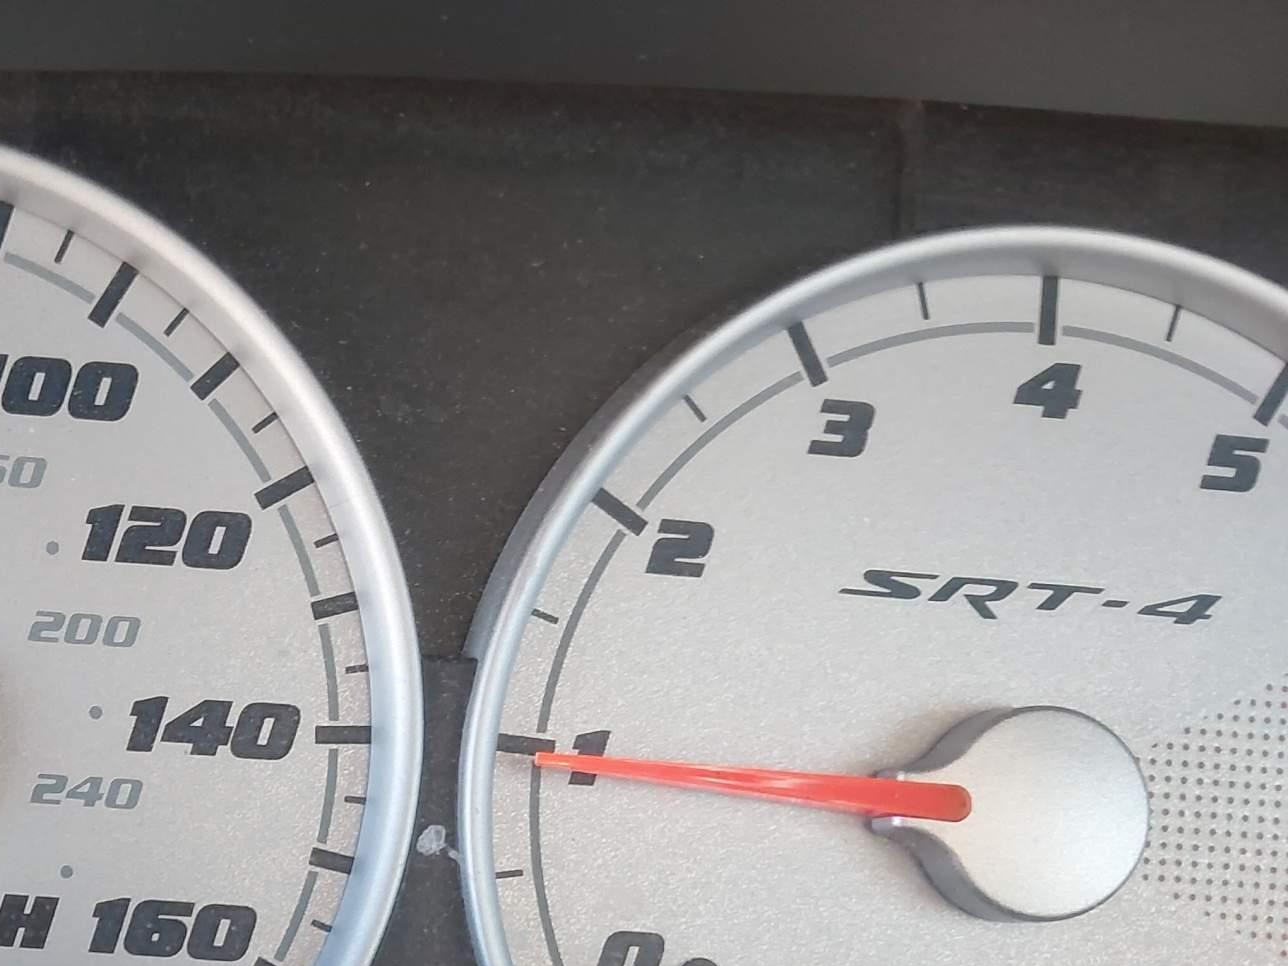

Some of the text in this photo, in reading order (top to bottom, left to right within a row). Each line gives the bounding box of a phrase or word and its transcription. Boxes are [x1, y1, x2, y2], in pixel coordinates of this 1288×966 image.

[1013, 363, 1082, 419] 4
[807, 400, 875, 457] 3
[1199, 434, 1270, 492] 5
[81, 504, 252, 570] 120
[645, 519, 714, 577] 2
[838, 570, 1222, 624] SRT-4
[27, 611, 141, 647] 200
[126, 696, 301, 760] 140
[30, 774, 143, 810] 240
[89, 897, 258, 962] 160
